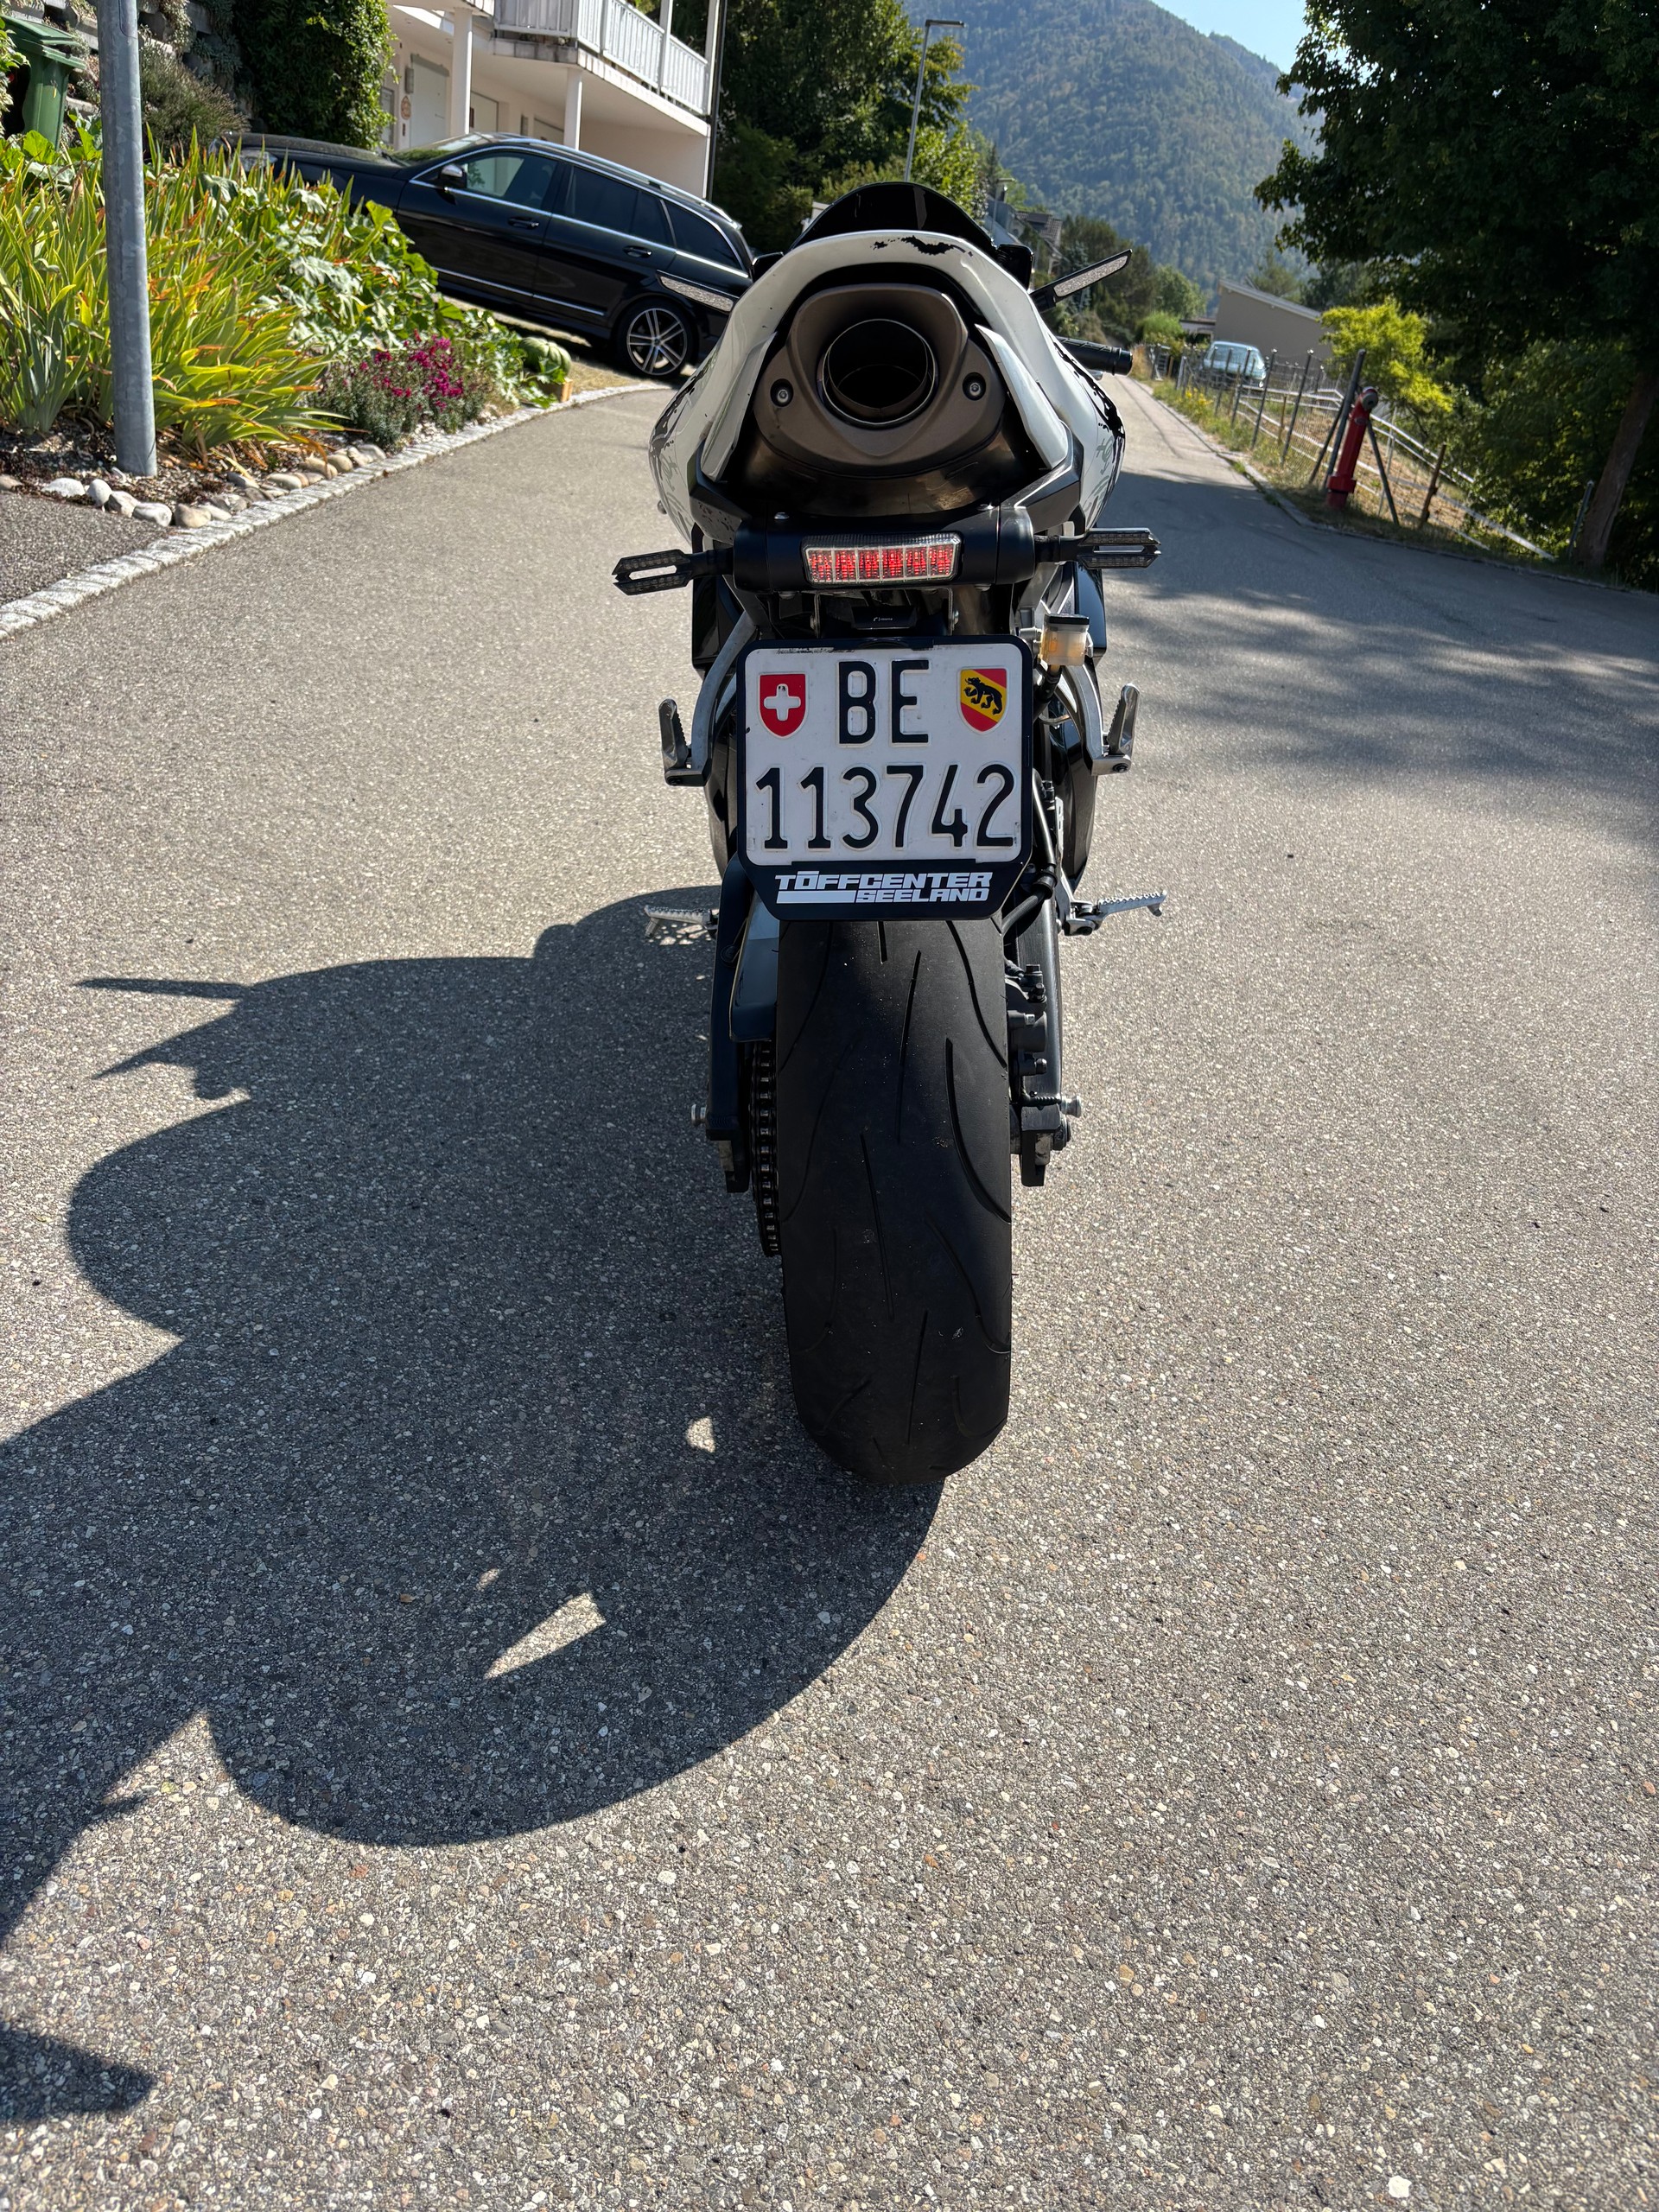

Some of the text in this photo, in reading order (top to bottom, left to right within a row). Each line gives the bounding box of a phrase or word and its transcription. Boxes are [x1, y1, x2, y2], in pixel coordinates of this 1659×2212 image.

[838, 659, 930, 745] BE
[754, 763, 1015, 850] 113742
[855, 888, 990, 904] SEELAND
